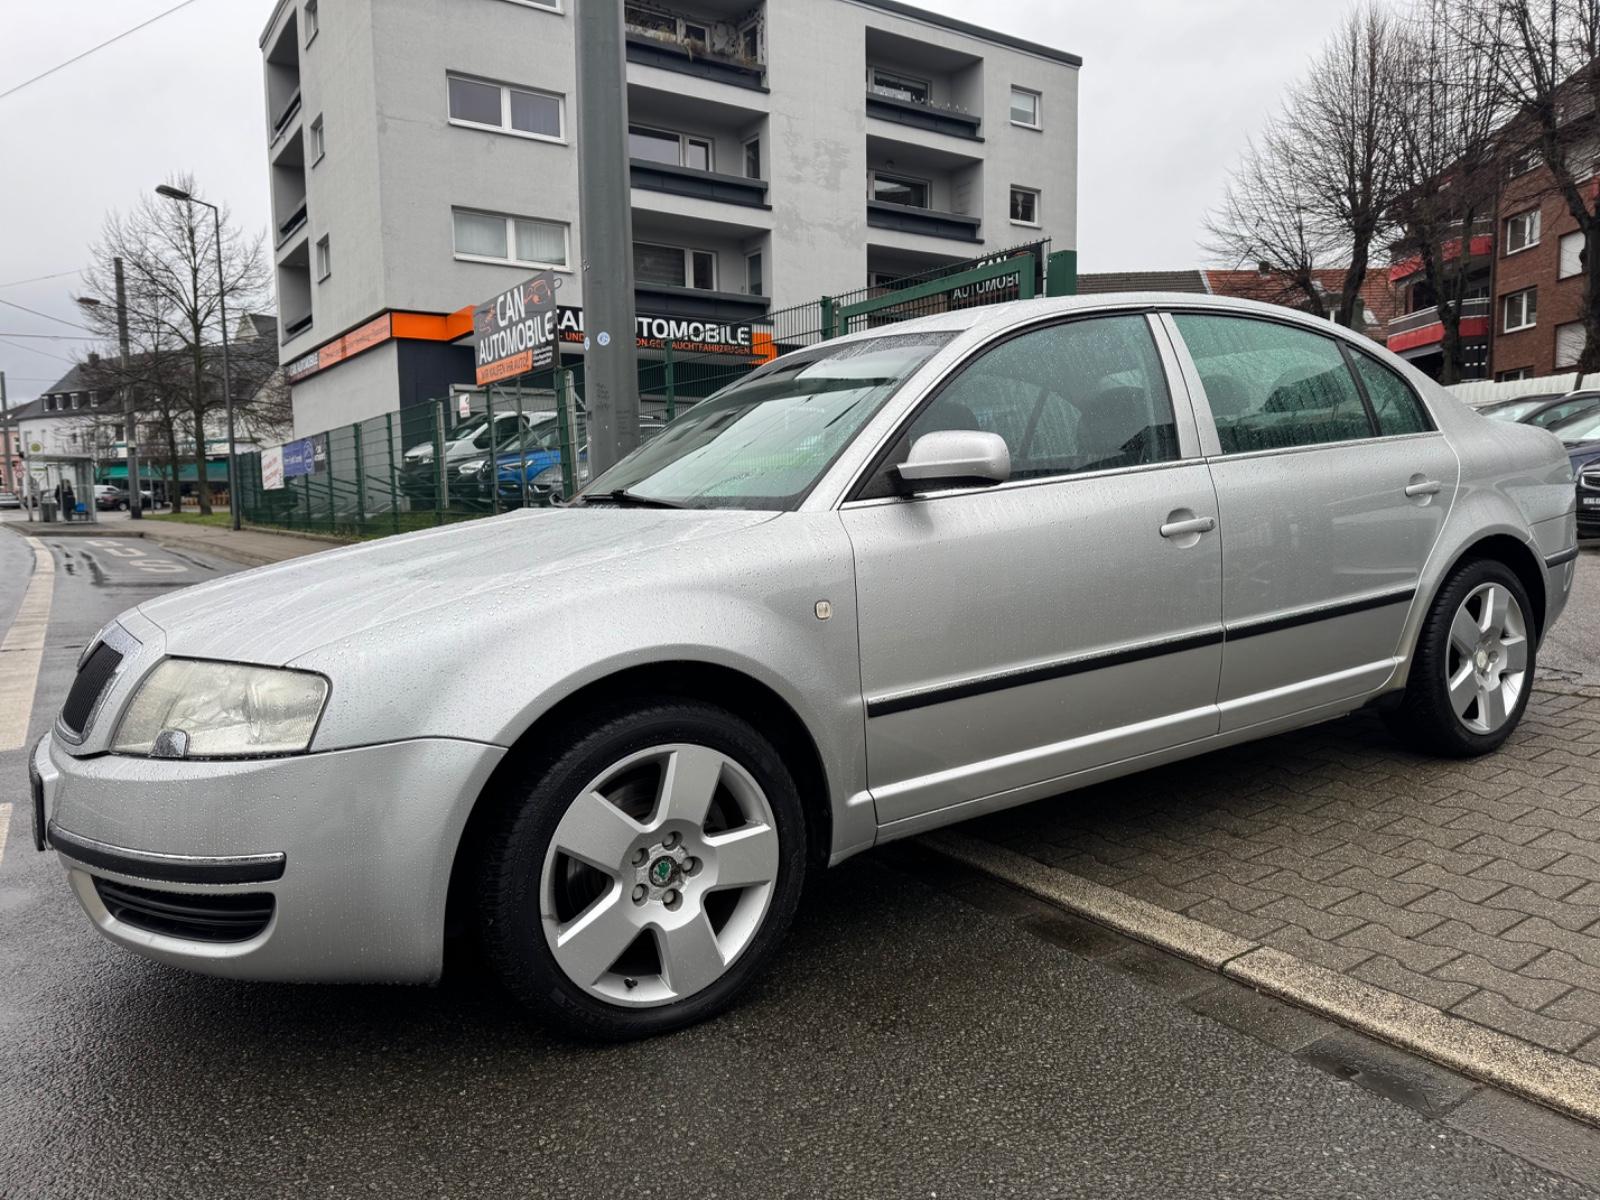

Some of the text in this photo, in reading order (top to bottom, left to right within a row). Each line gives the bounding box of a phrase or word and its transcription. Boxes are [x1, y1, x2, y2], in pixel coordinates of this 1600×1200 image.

[952, 272, 1019, 300] AUTOMOBI
[496, 285, 526, 327] CAN
[479, 310, 555, 365] AUTOMOBILE
[634, 317, 750, 345] TOMOBILE
